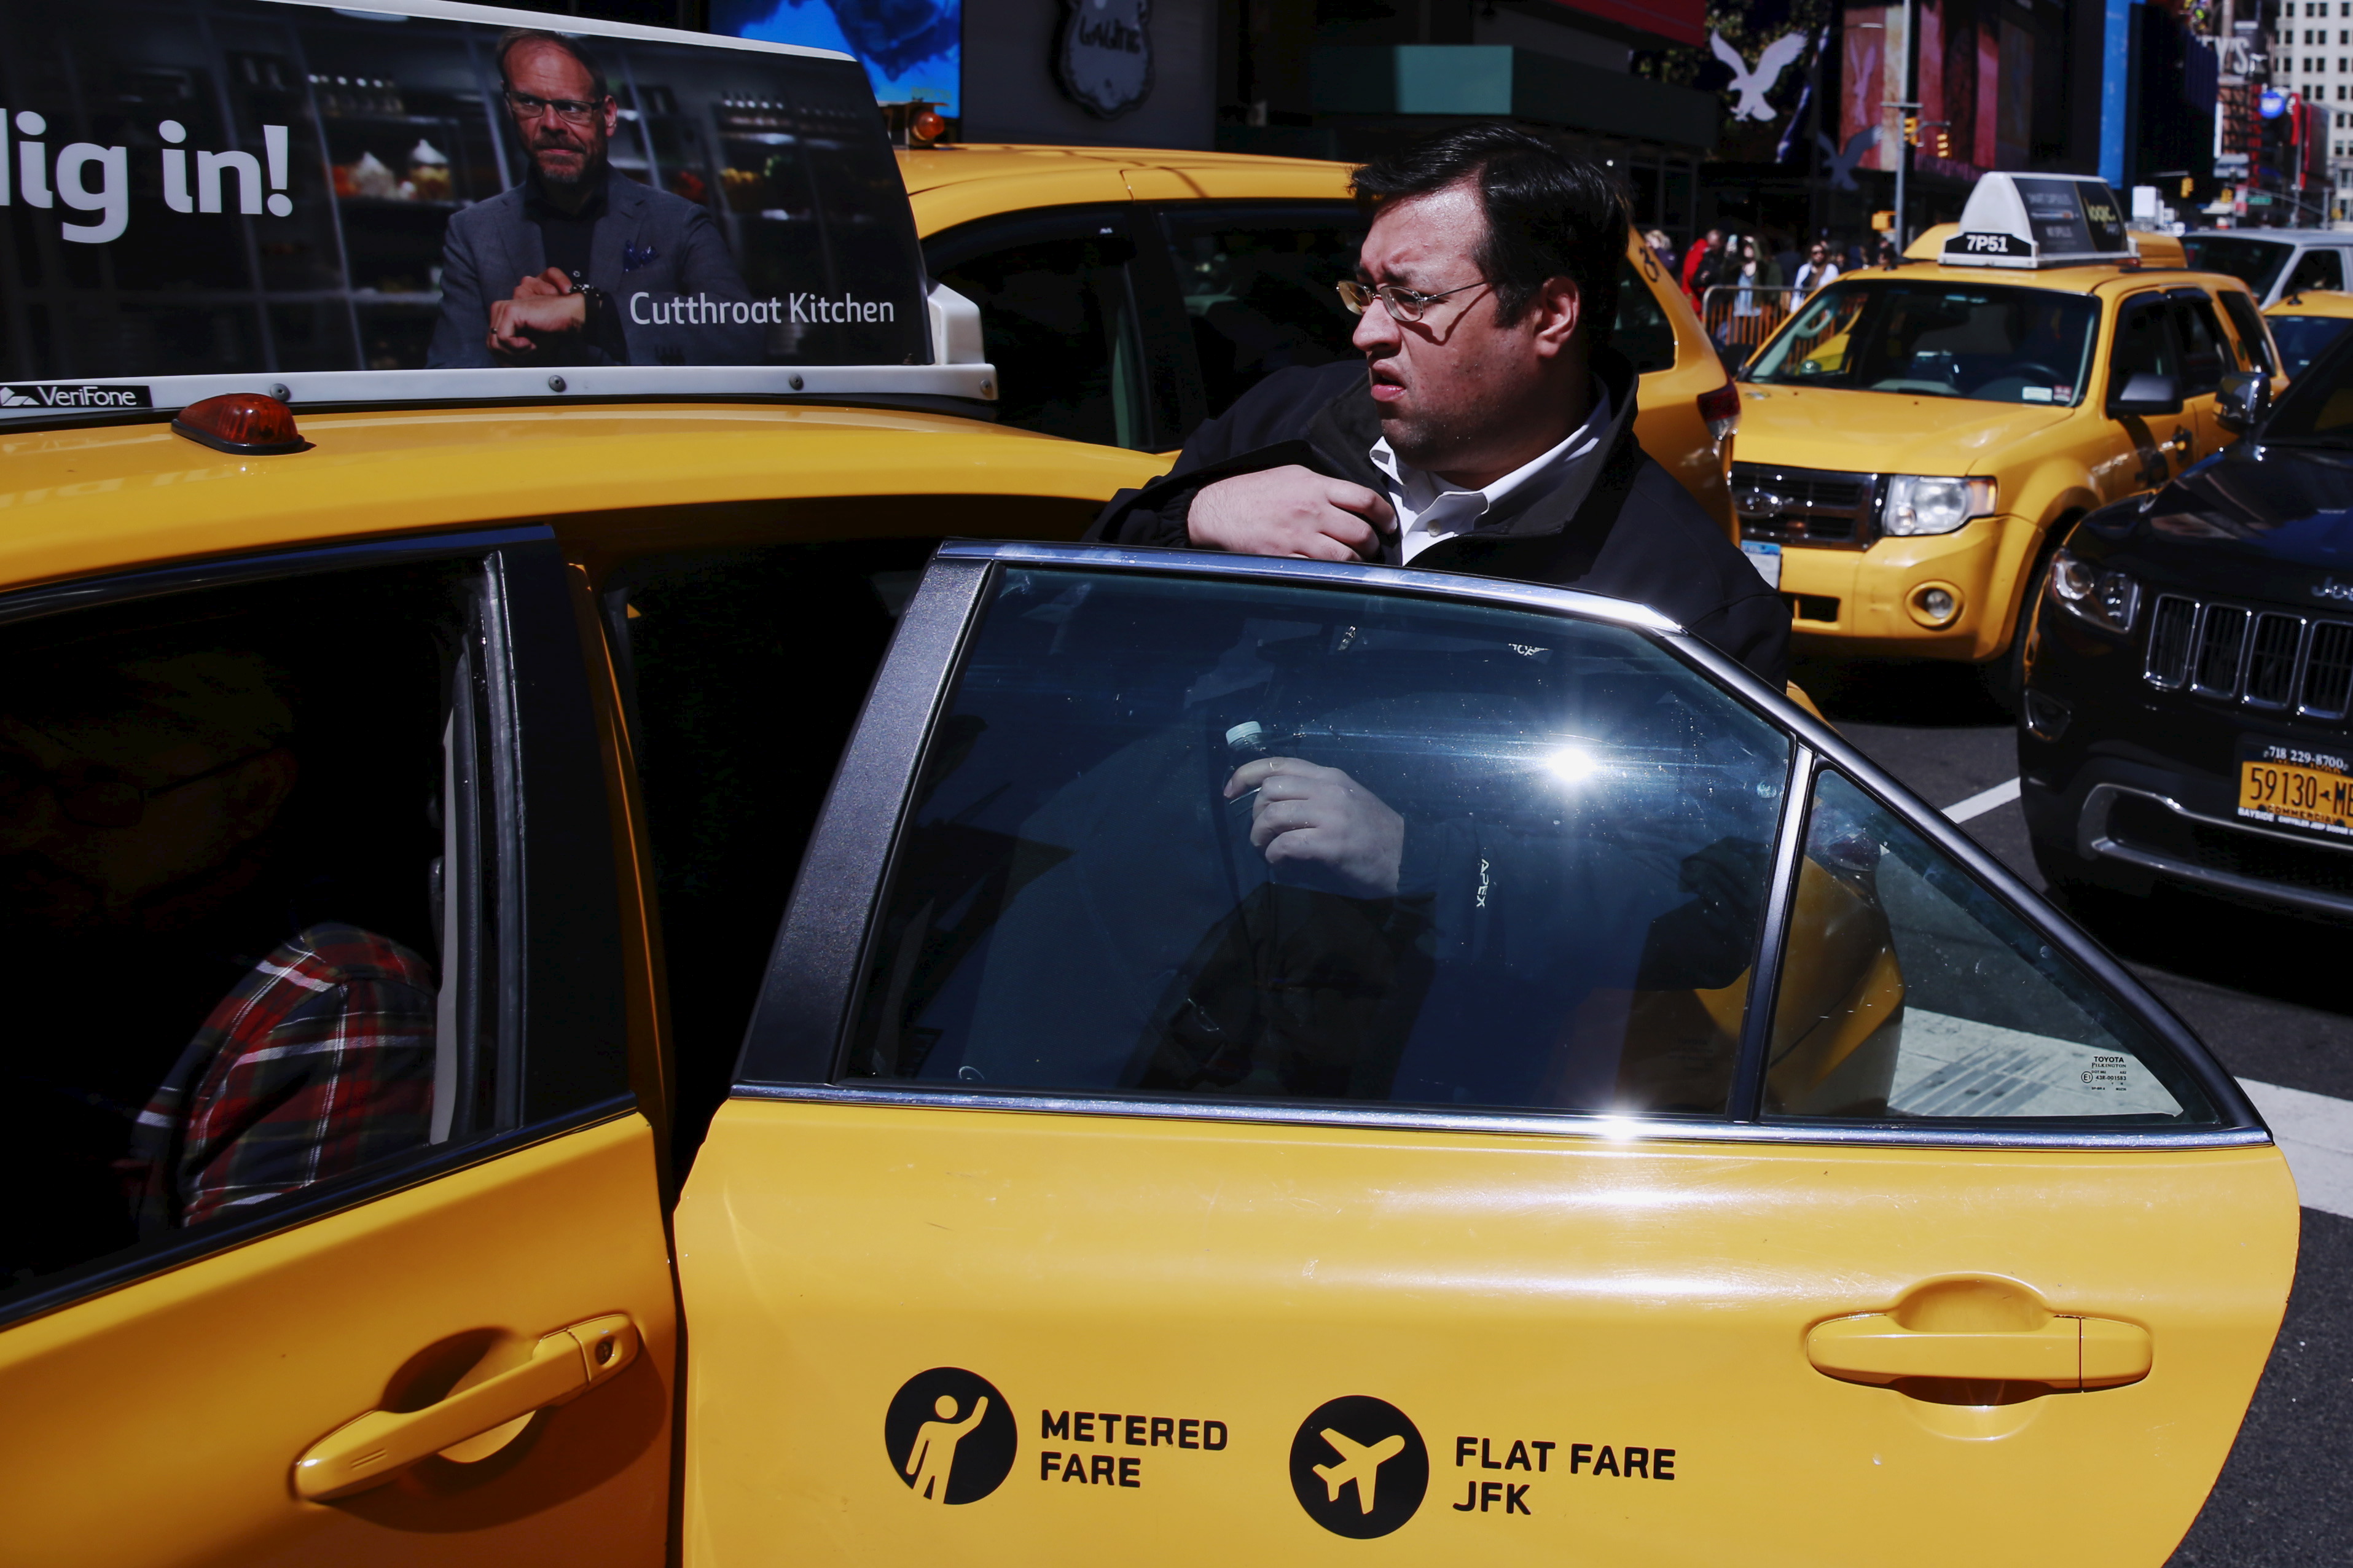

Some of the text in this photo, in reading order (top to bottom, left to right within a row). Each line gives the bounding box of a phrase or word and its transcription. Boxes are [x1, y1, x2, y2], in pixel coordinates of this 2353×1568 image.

[159, 120, 293, 217] in!
[1966, 234, 2008, 252] 7P51
[630, 292, 895, 324] Cutthroat Kitchen
[37, 386, 136, 405] VeriFone
[2269, 746, 2287, 760] 718
[2290, 749, 2344, 768] 229-8700
[2250, 767, 2317, 809] 59130
[2238, 807, 2275, 822] BAYSIDE
[1476, 858, 1489, 908] APEX
[1042, 1409, 1227, 1451] METERED
[1041, 1451, 1141, 1488] FARE
[1456, 1436, 1676, 1480] FLAT FARE
[1452, 1481, 1532, 1515] JFK
